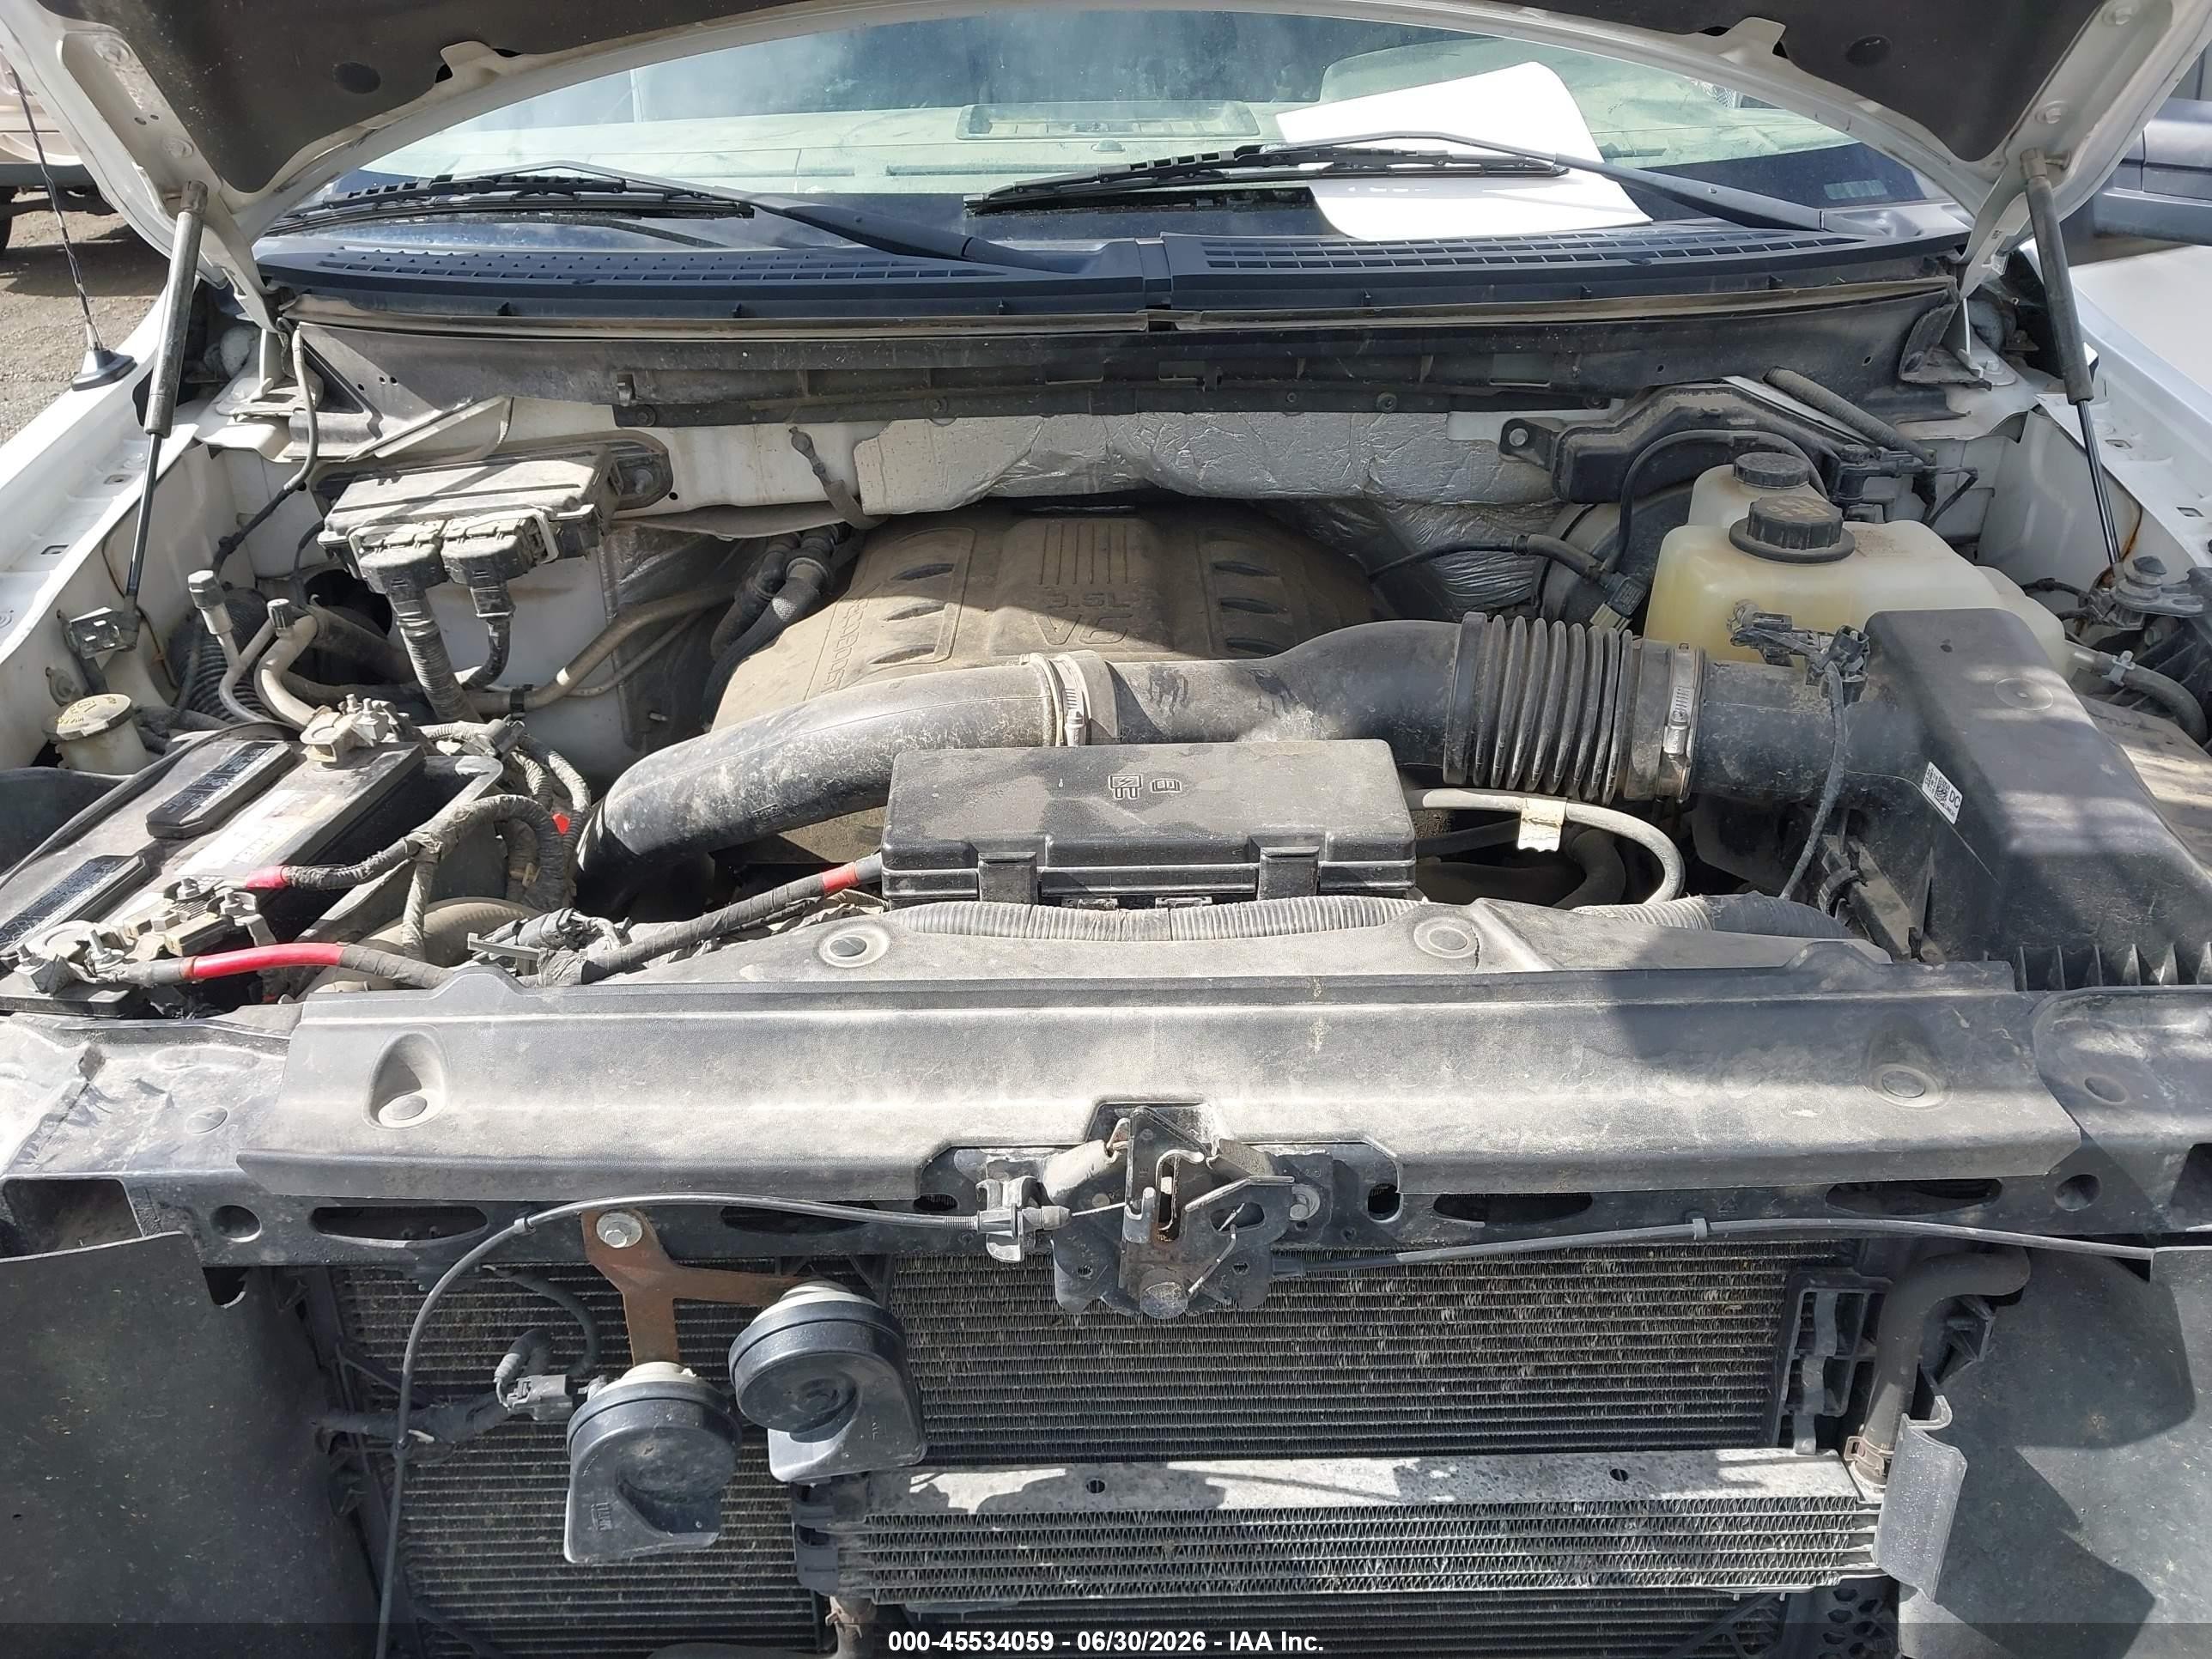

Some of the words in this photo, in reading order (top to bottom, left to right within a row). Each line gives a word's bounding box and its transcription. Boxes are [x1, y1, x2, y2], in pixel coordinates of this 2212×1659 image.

[1042, 587, 1132, 609] 3.5L
[1032, 611, 1135, 646] V6
[1948, 789, 1961, 809] DC
